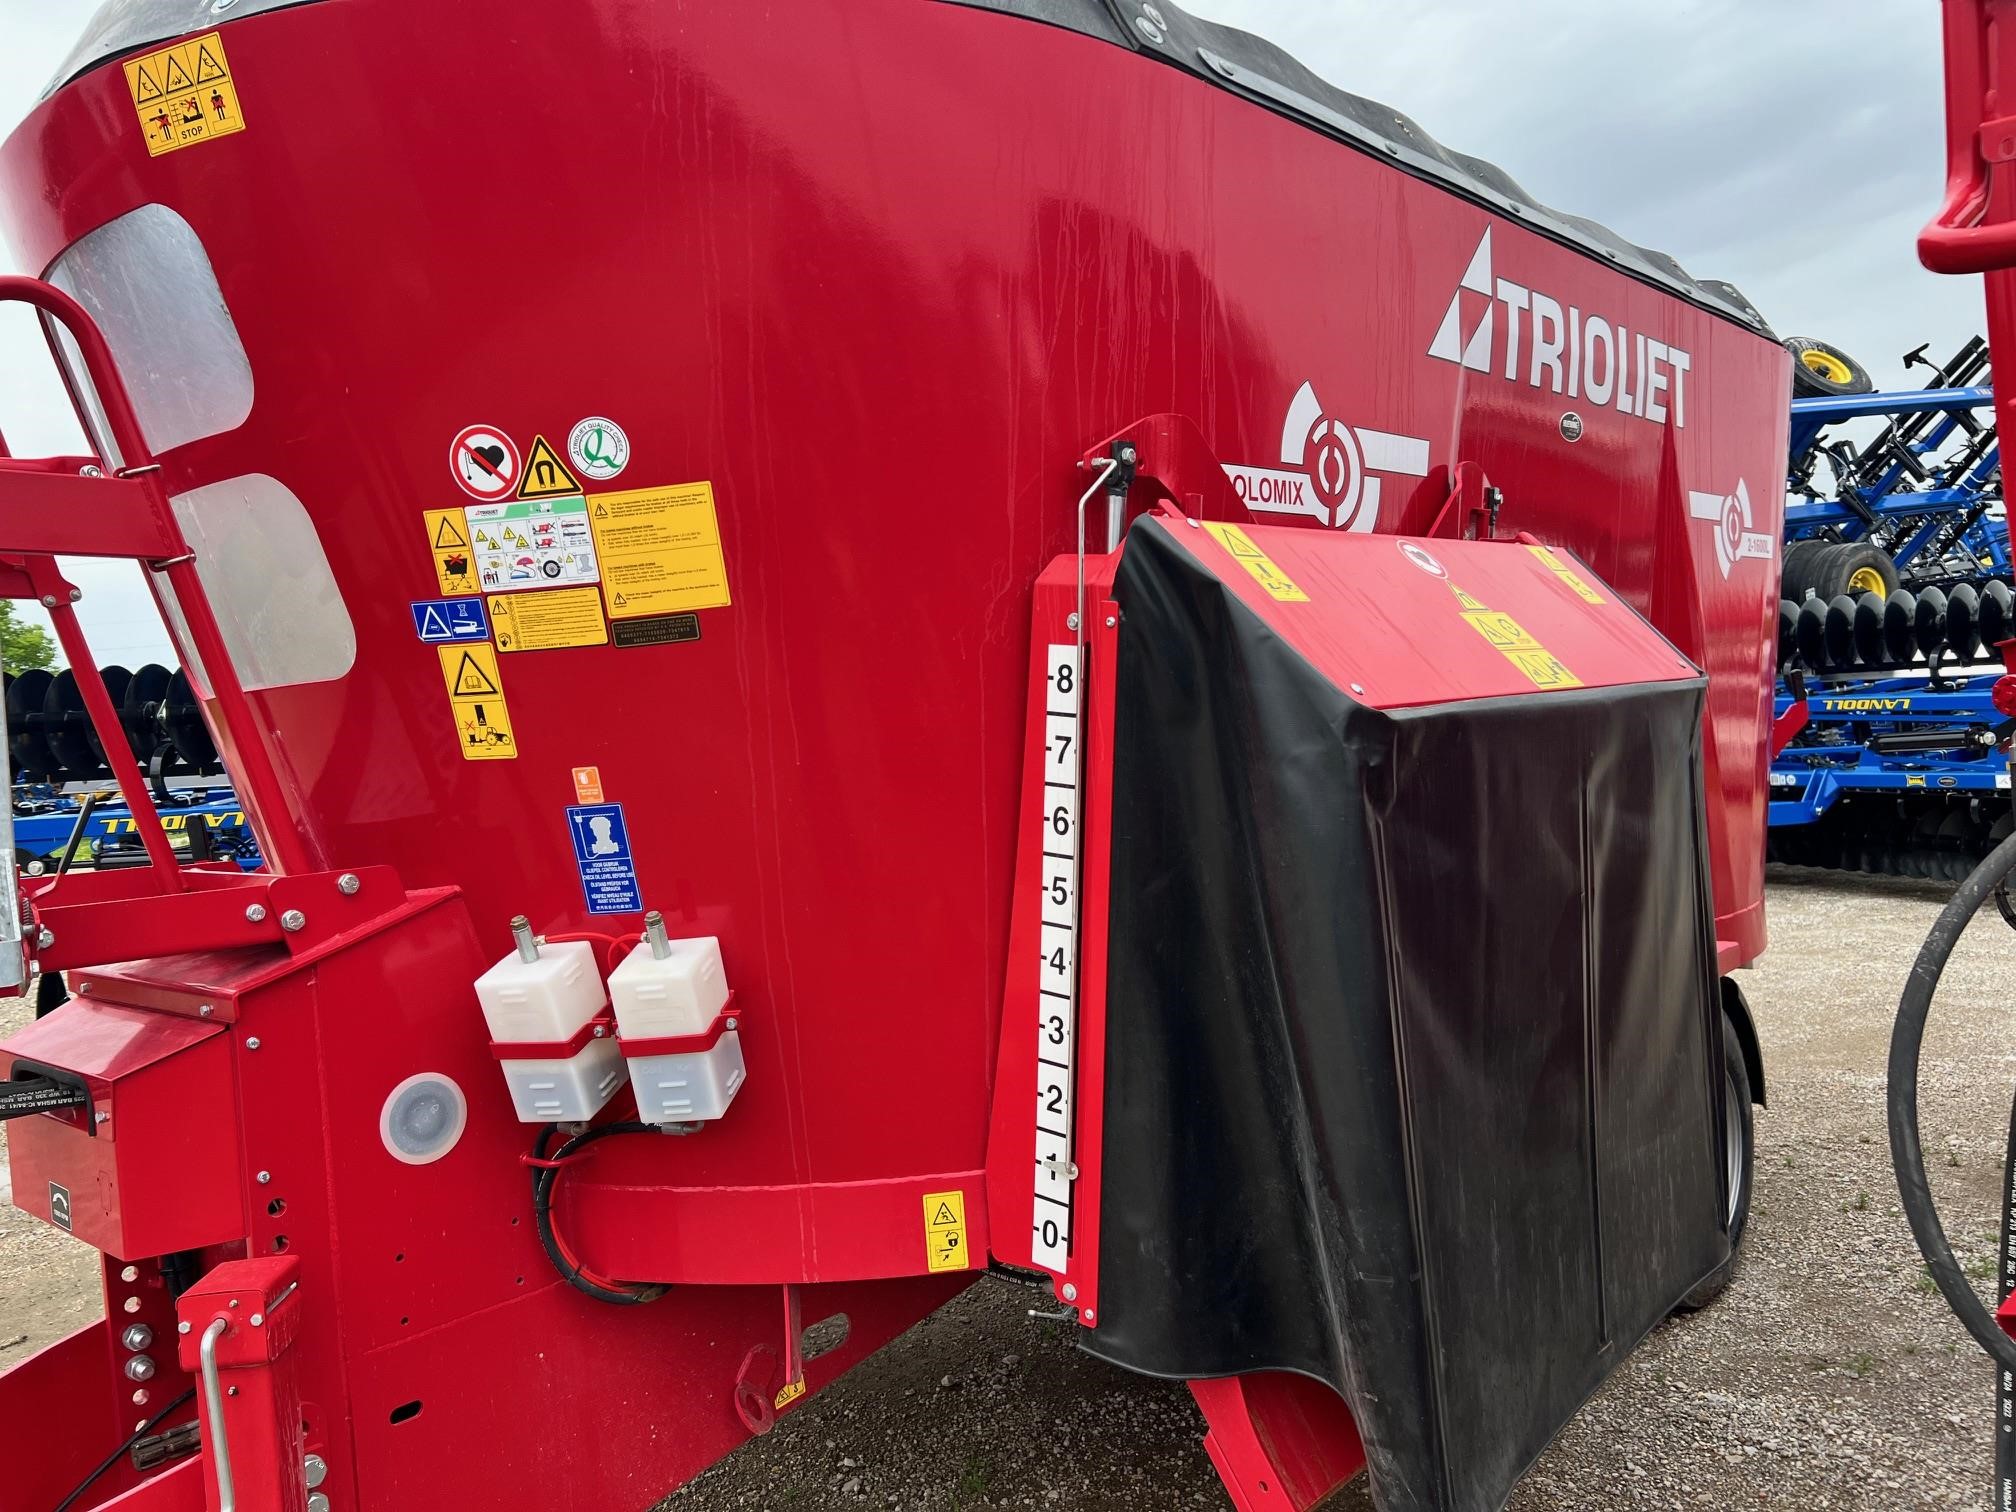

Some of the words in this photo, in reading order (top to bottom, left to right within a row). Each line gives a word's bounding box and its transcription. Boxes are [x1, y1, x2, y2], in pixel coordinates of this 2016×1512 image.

[181, 126, 203, 139] STOP
[1496, 277, 1690, 428] TRIOLIET
[587, 421, 614, 432] QUALITY
[1232, 474, 1304, 506] OLOMIX
[1056, 664, 1074, 694] 8
[1822, 698, 1912, 712] LANDOLL
[1054, 735, 1072, 764] 7
[100, 811, 246, 834] LADLL
[1052, 806, 1070, 836] 6
[1051, 876, 1068, 906] 5
[1049, 947, 1066, 976] 4
[1047, 1015, 1064, 1045] 3
[1046, 1084, 1063, 1115] 2
[1046, 1153, 1057, 1181] 1
[1042, 1219, 1058, 1249] 0
[2006, 1279, 2015, 1288] 12
